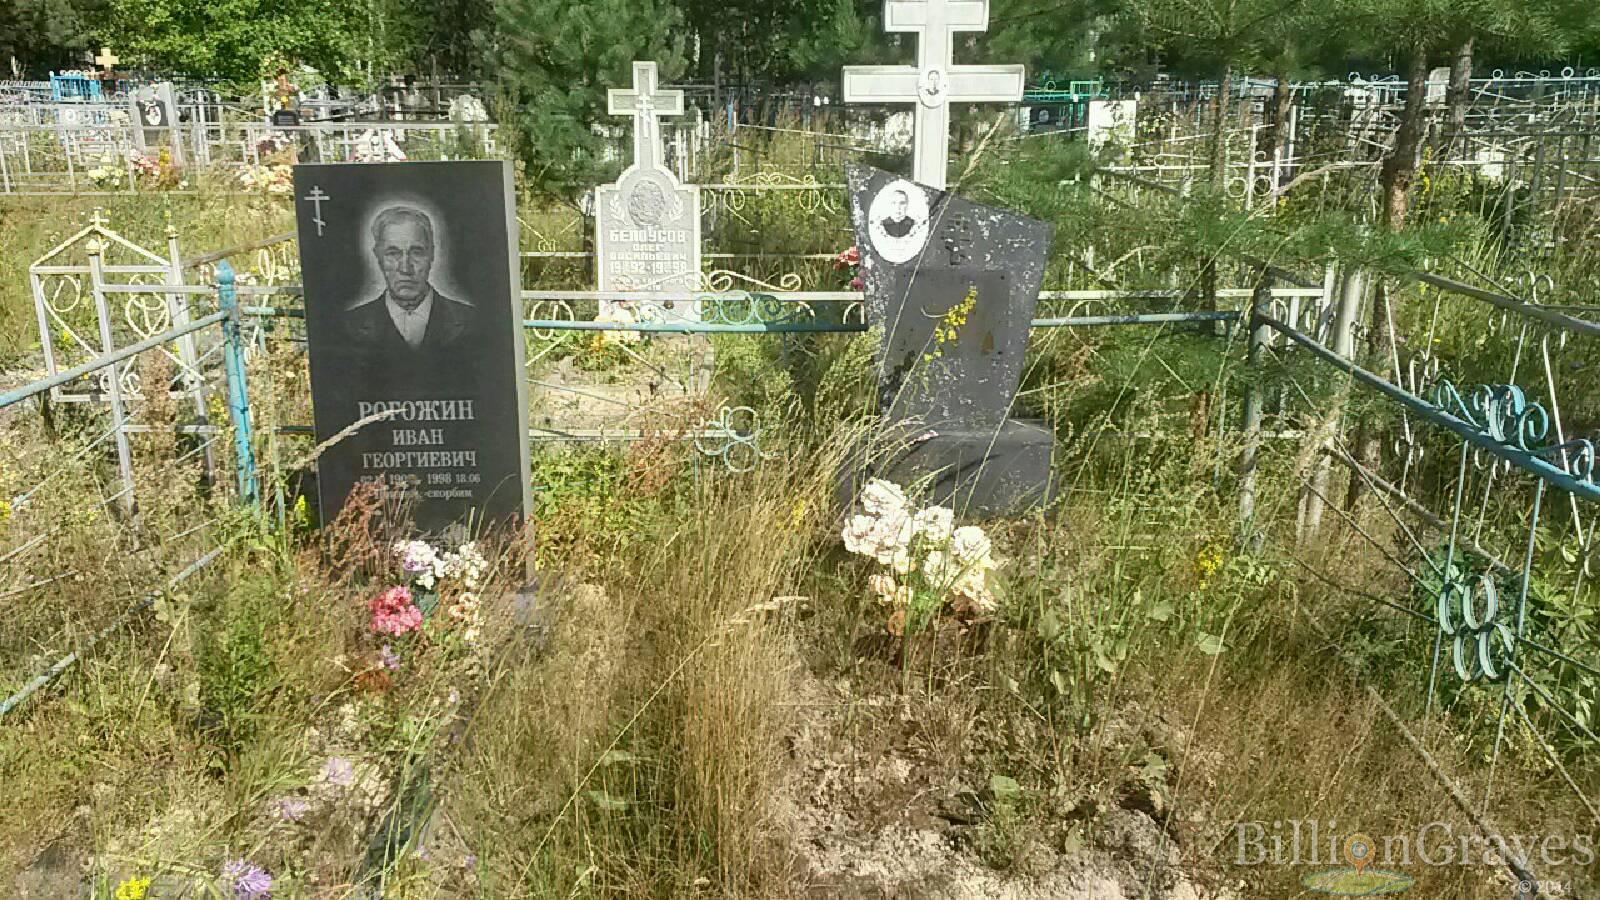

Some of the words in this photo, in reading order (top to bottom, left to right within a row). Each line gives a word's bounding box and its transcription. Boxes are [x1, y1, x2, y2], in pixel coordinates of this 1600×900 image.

[609, 229, 686, 243] БЕЛОУСОВ
[358, 400, 475, 421] РОГОЖИН
[392, 428, 445, 446] ИВАН
[362, 450, 477, 468] ГЕОРГИЕВИЧ
[427, 473, 452, 485] 1998
